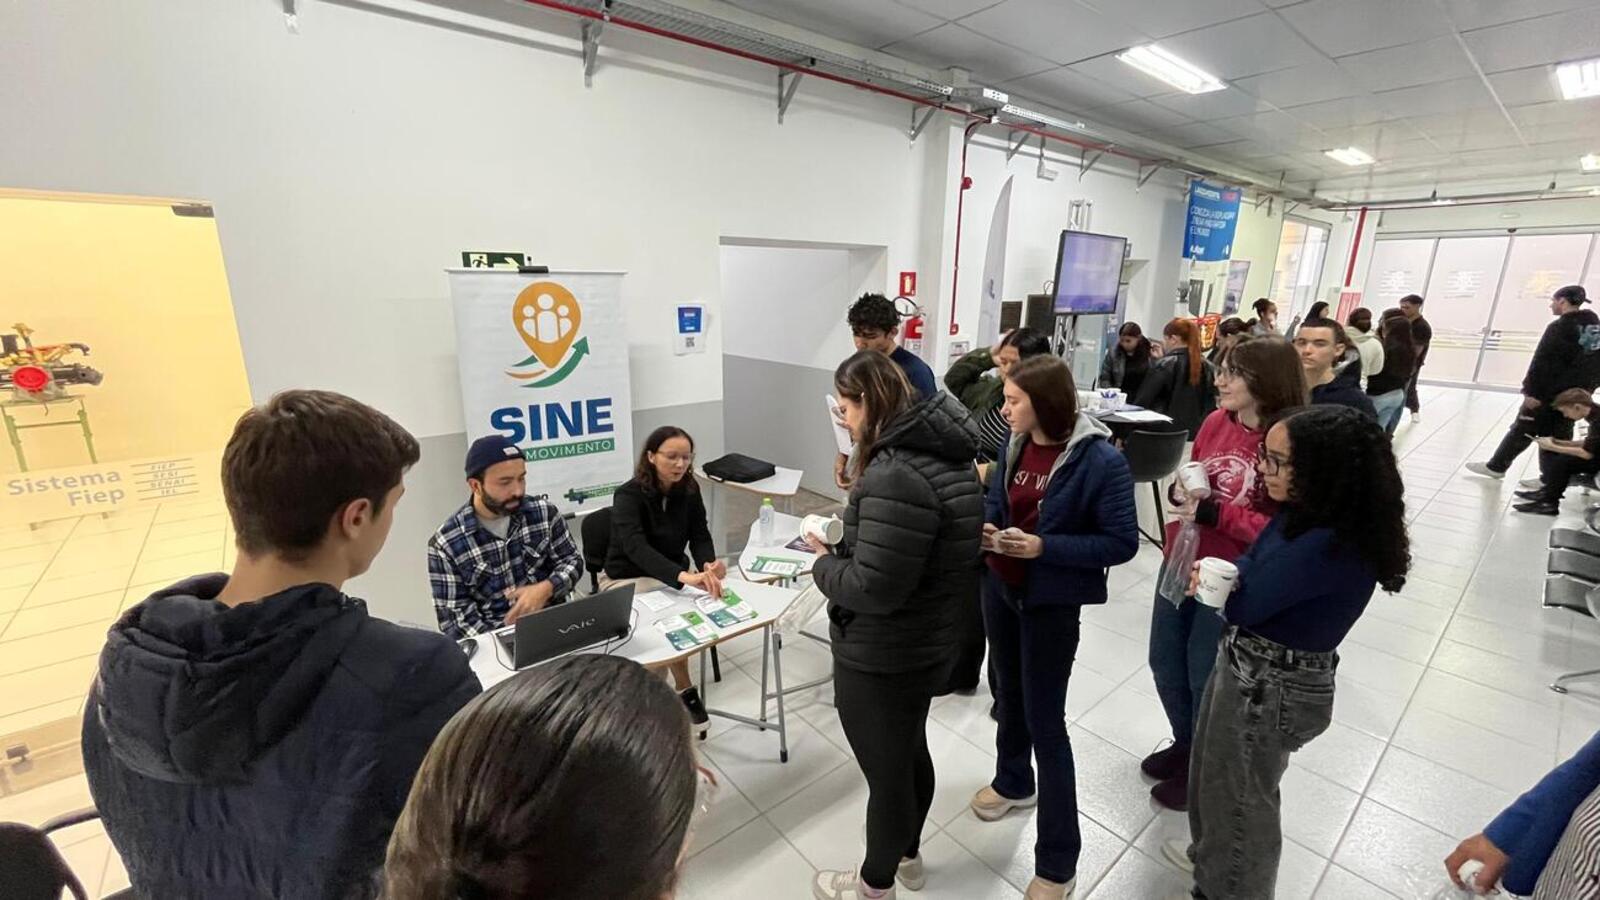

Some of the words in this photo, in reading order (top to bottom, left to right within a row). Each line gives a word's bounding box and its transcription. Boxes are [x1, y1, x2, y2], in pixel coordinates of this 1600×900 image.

[490, 397, 614, 445] SINE
[526, 440, 611, 460] MOVIMENTO
[7, 470, 122, 496] Sistema
[67, 487, 125, 507] Fiep
